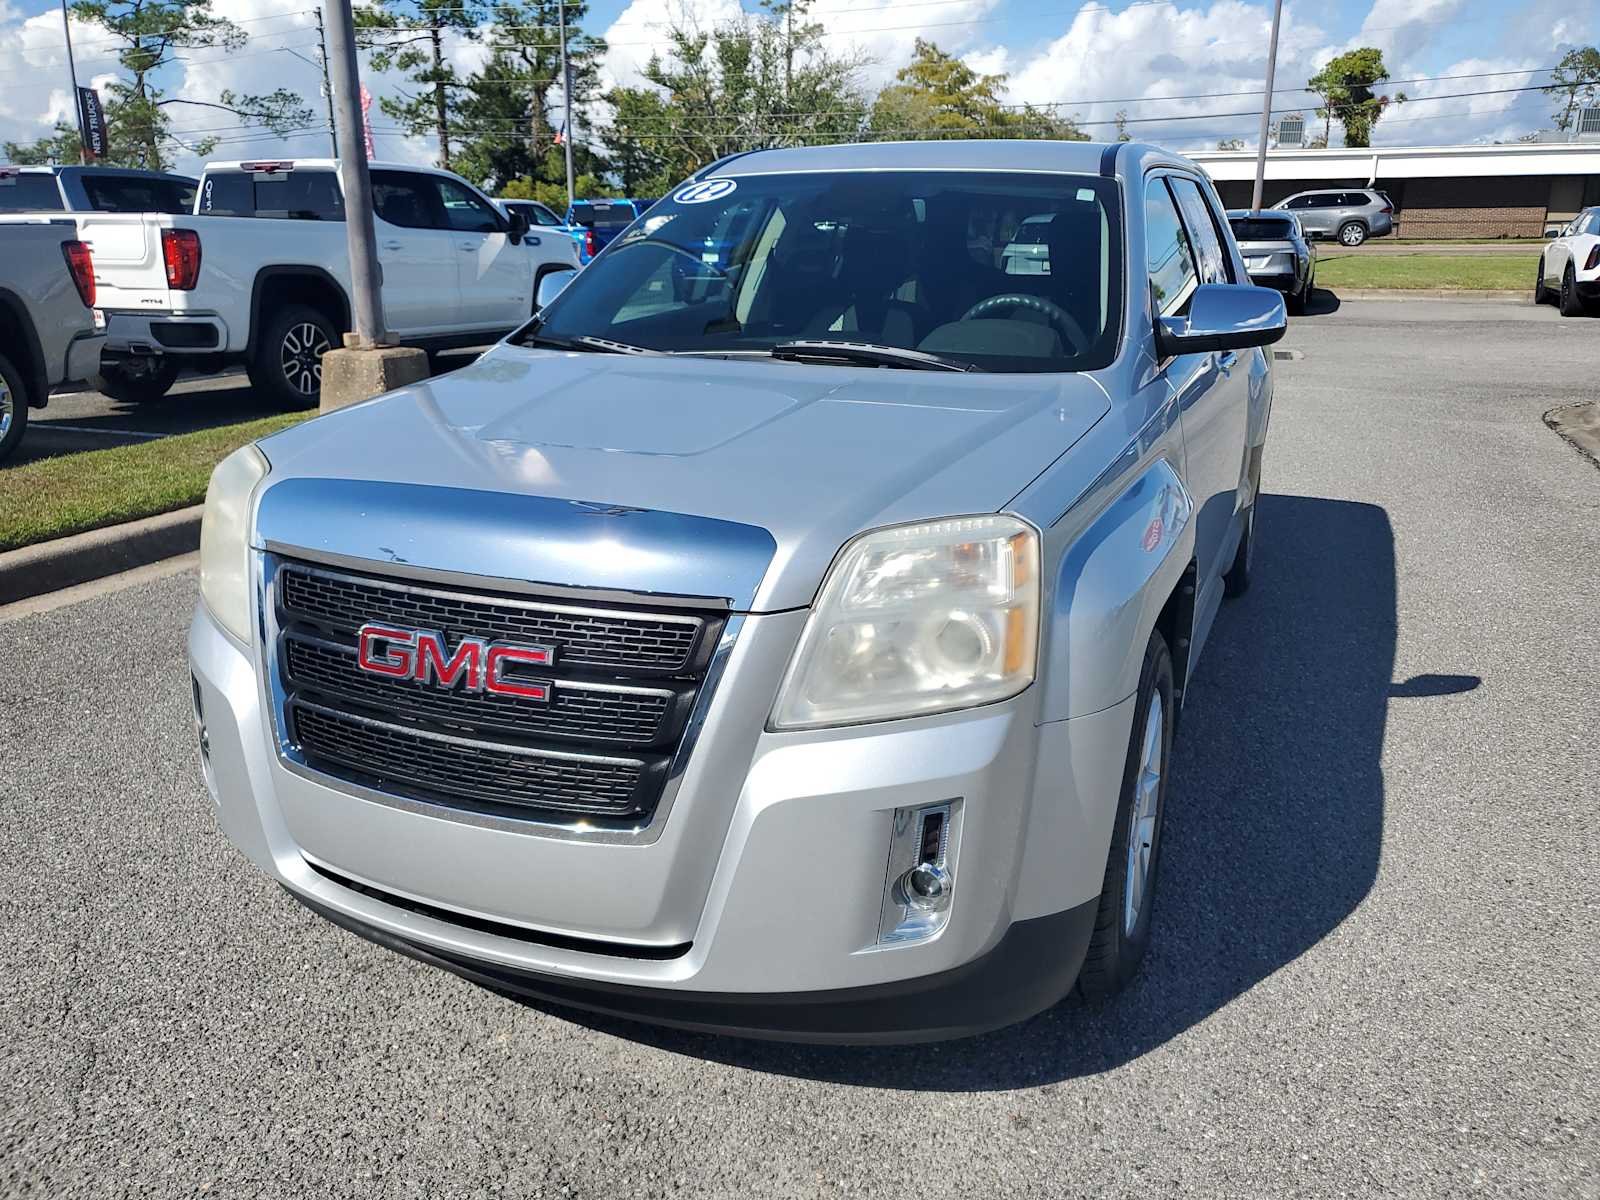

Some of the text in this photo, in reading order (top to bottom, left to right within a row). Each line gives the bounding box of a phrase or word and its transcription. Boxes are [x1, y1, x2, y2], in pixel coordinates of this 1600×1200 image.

[85, 91, 102, 154] NEW TRUCKS
[358, 619, 554, 702] GMC
